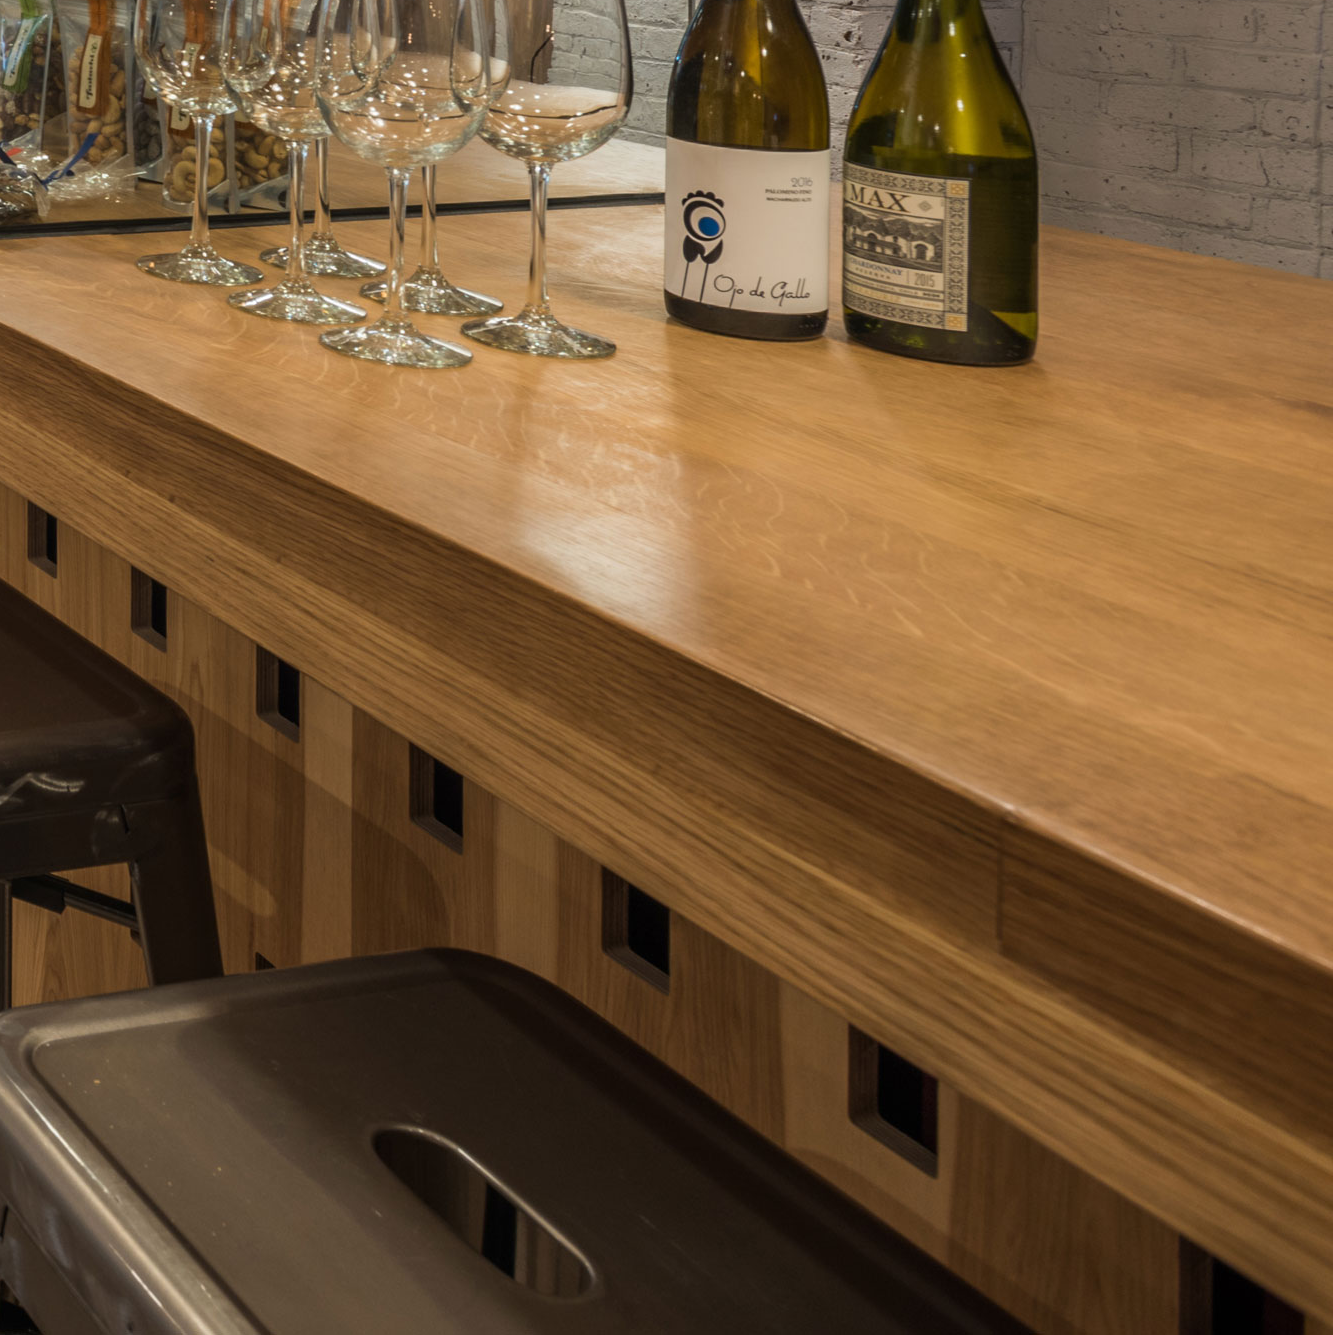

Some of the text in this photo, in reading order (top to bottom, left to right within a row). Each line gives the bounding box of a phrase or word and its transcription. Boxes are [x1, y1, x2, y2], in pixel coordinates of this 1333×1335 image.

[790, 177, 813, 187] 2016
[850, 184, 911, 213] MAX
[915, 273, 935, 287] 2015
[714, 274, 811, 309] Ojo de Gallo
